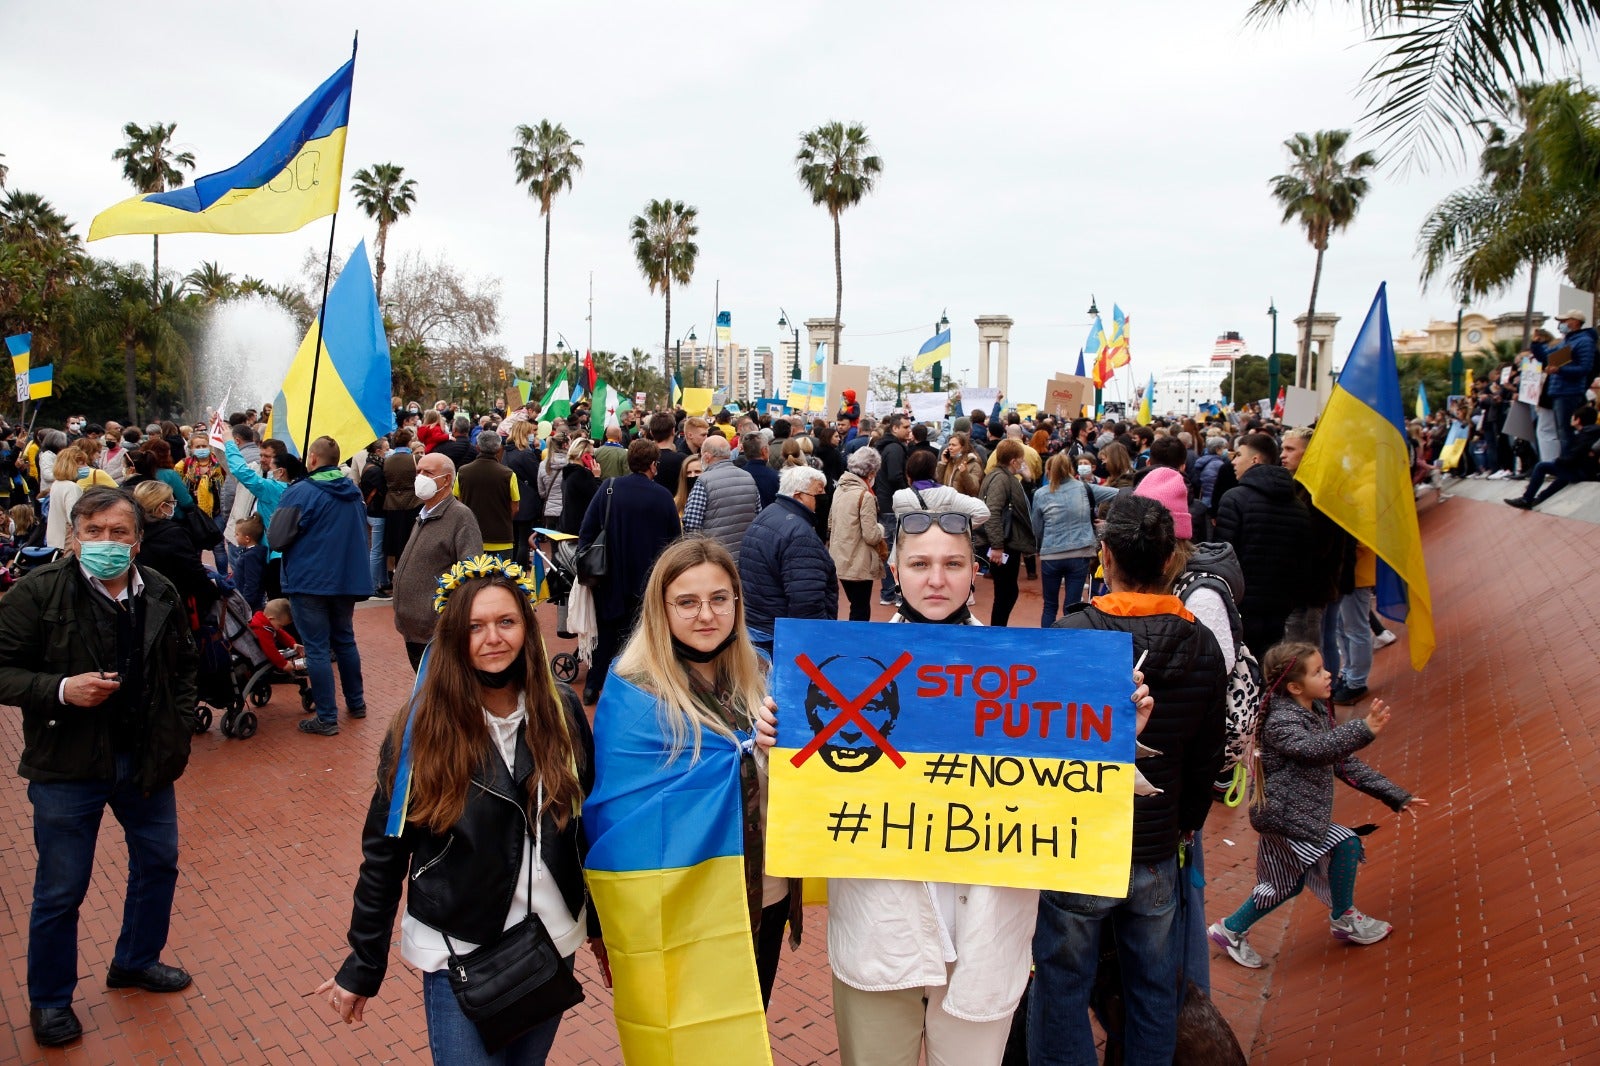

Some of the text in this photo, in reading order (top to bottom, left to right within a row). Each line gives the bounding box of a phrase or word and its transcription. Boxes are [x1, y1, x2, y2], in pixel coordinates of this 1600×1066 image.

[916, 664, 1037, 699] STOP
[974, 700, 1113, 742] PUTIN
[827, 801, 1078, 859] #НіВійні
